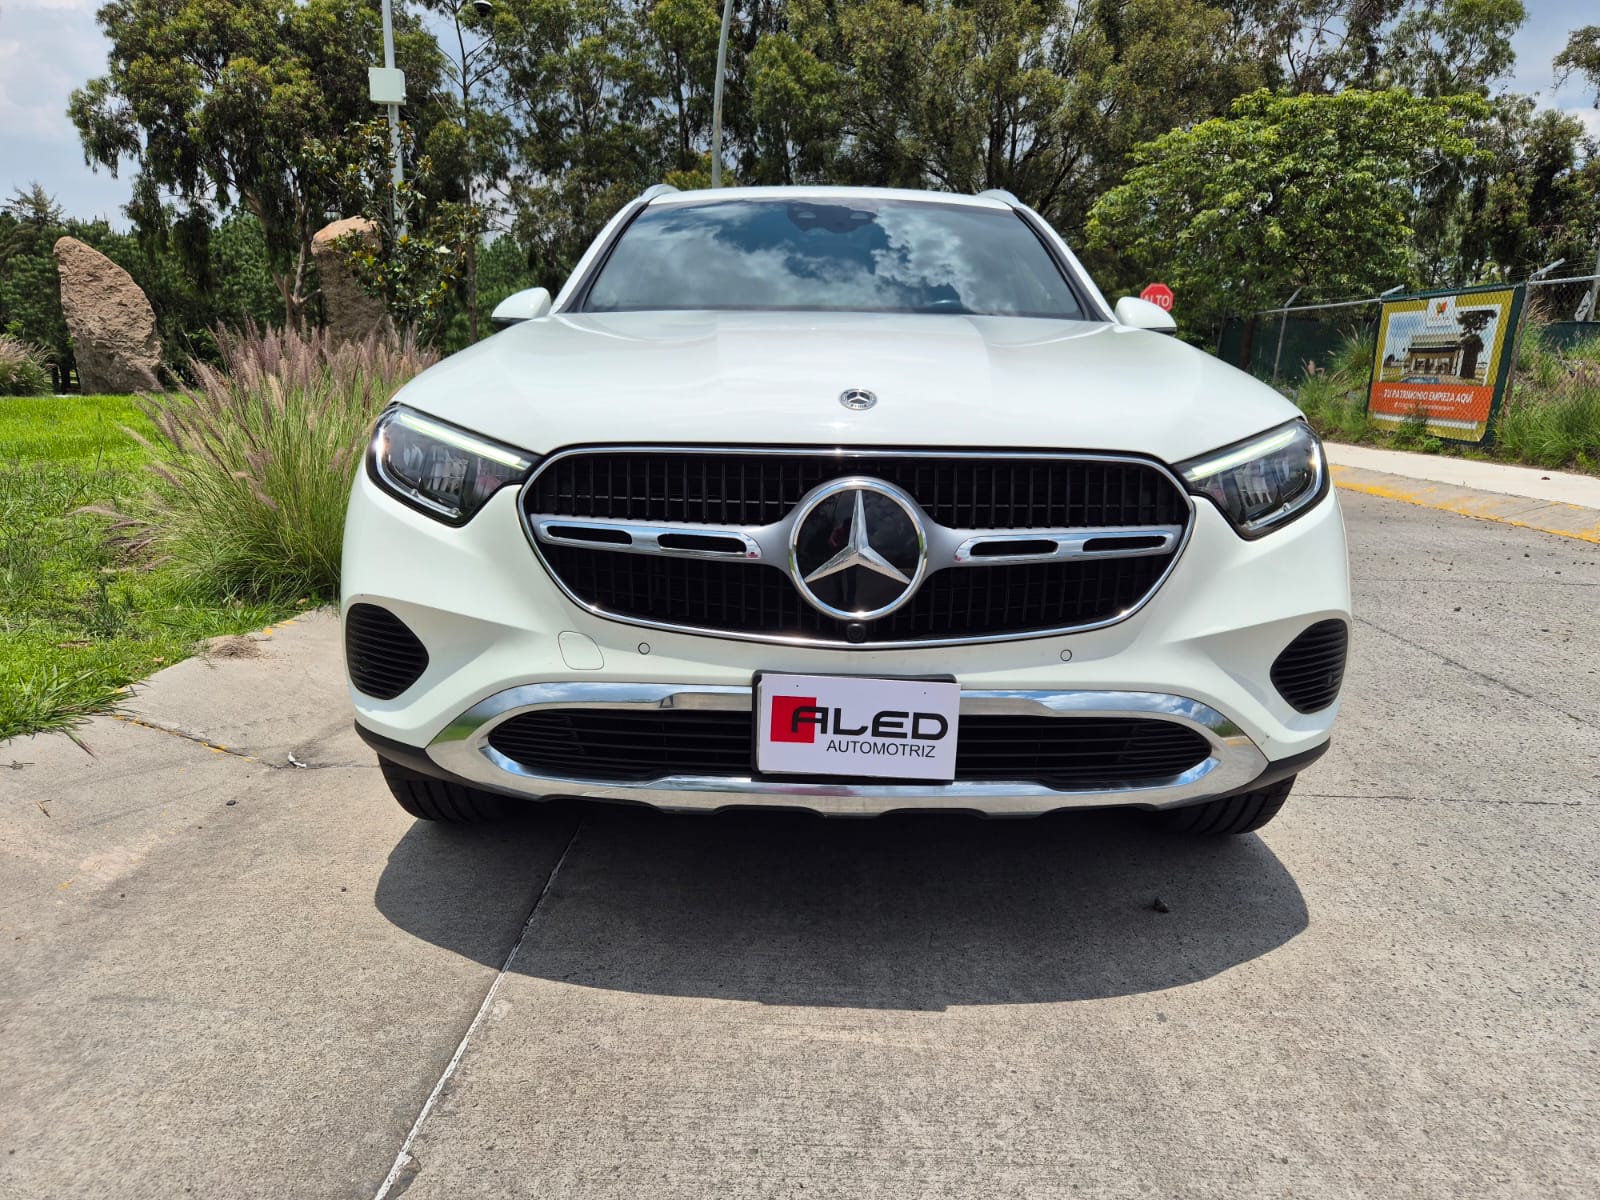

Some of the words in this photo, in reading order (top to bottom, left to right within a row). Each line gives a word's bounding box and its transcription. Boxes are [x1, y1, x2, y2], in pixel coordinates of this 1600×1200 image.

[1391, 389, 1428, 401] PATRIMONIO
[1429, 391, 1455, 402] EMPIEZA
[1455, 391, 1475, 404] AQUÍ
[791, 706, 949, 741] ALED
[826, 739, 936, 758] AUTOMOTRIZ
